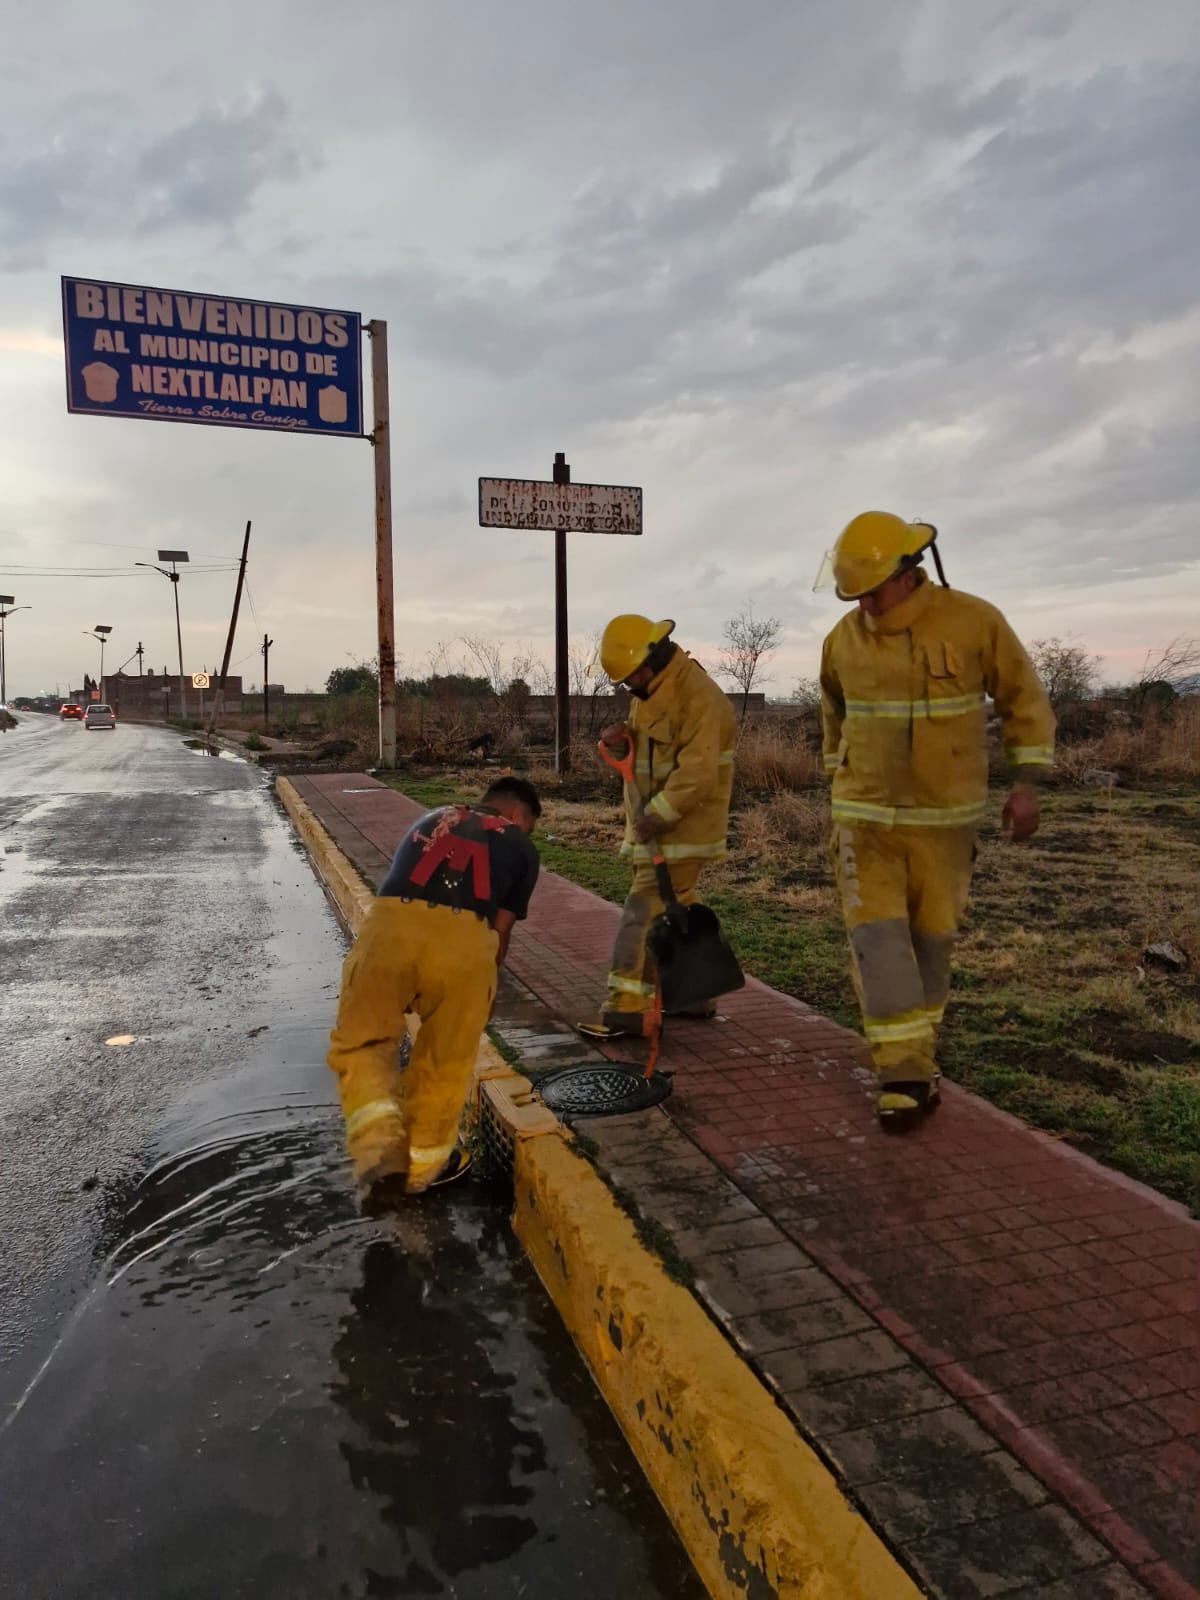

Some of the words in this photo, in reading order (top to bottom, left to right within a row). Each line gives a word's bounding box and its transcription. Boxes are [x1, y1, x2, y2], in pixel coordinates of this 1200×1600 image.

[75, 283, 349, 348] BIENVENIDOS
[93, 329, 131, 354] AL
[139, 333, 299, 373] MUNICIPIO
[305, 352, 338, 377] DE
[131, 363, 308, 409] NEXTLALPAN
[138, 399, 194, 416] Tierra
[198, 404, 249, 421] Sobre
